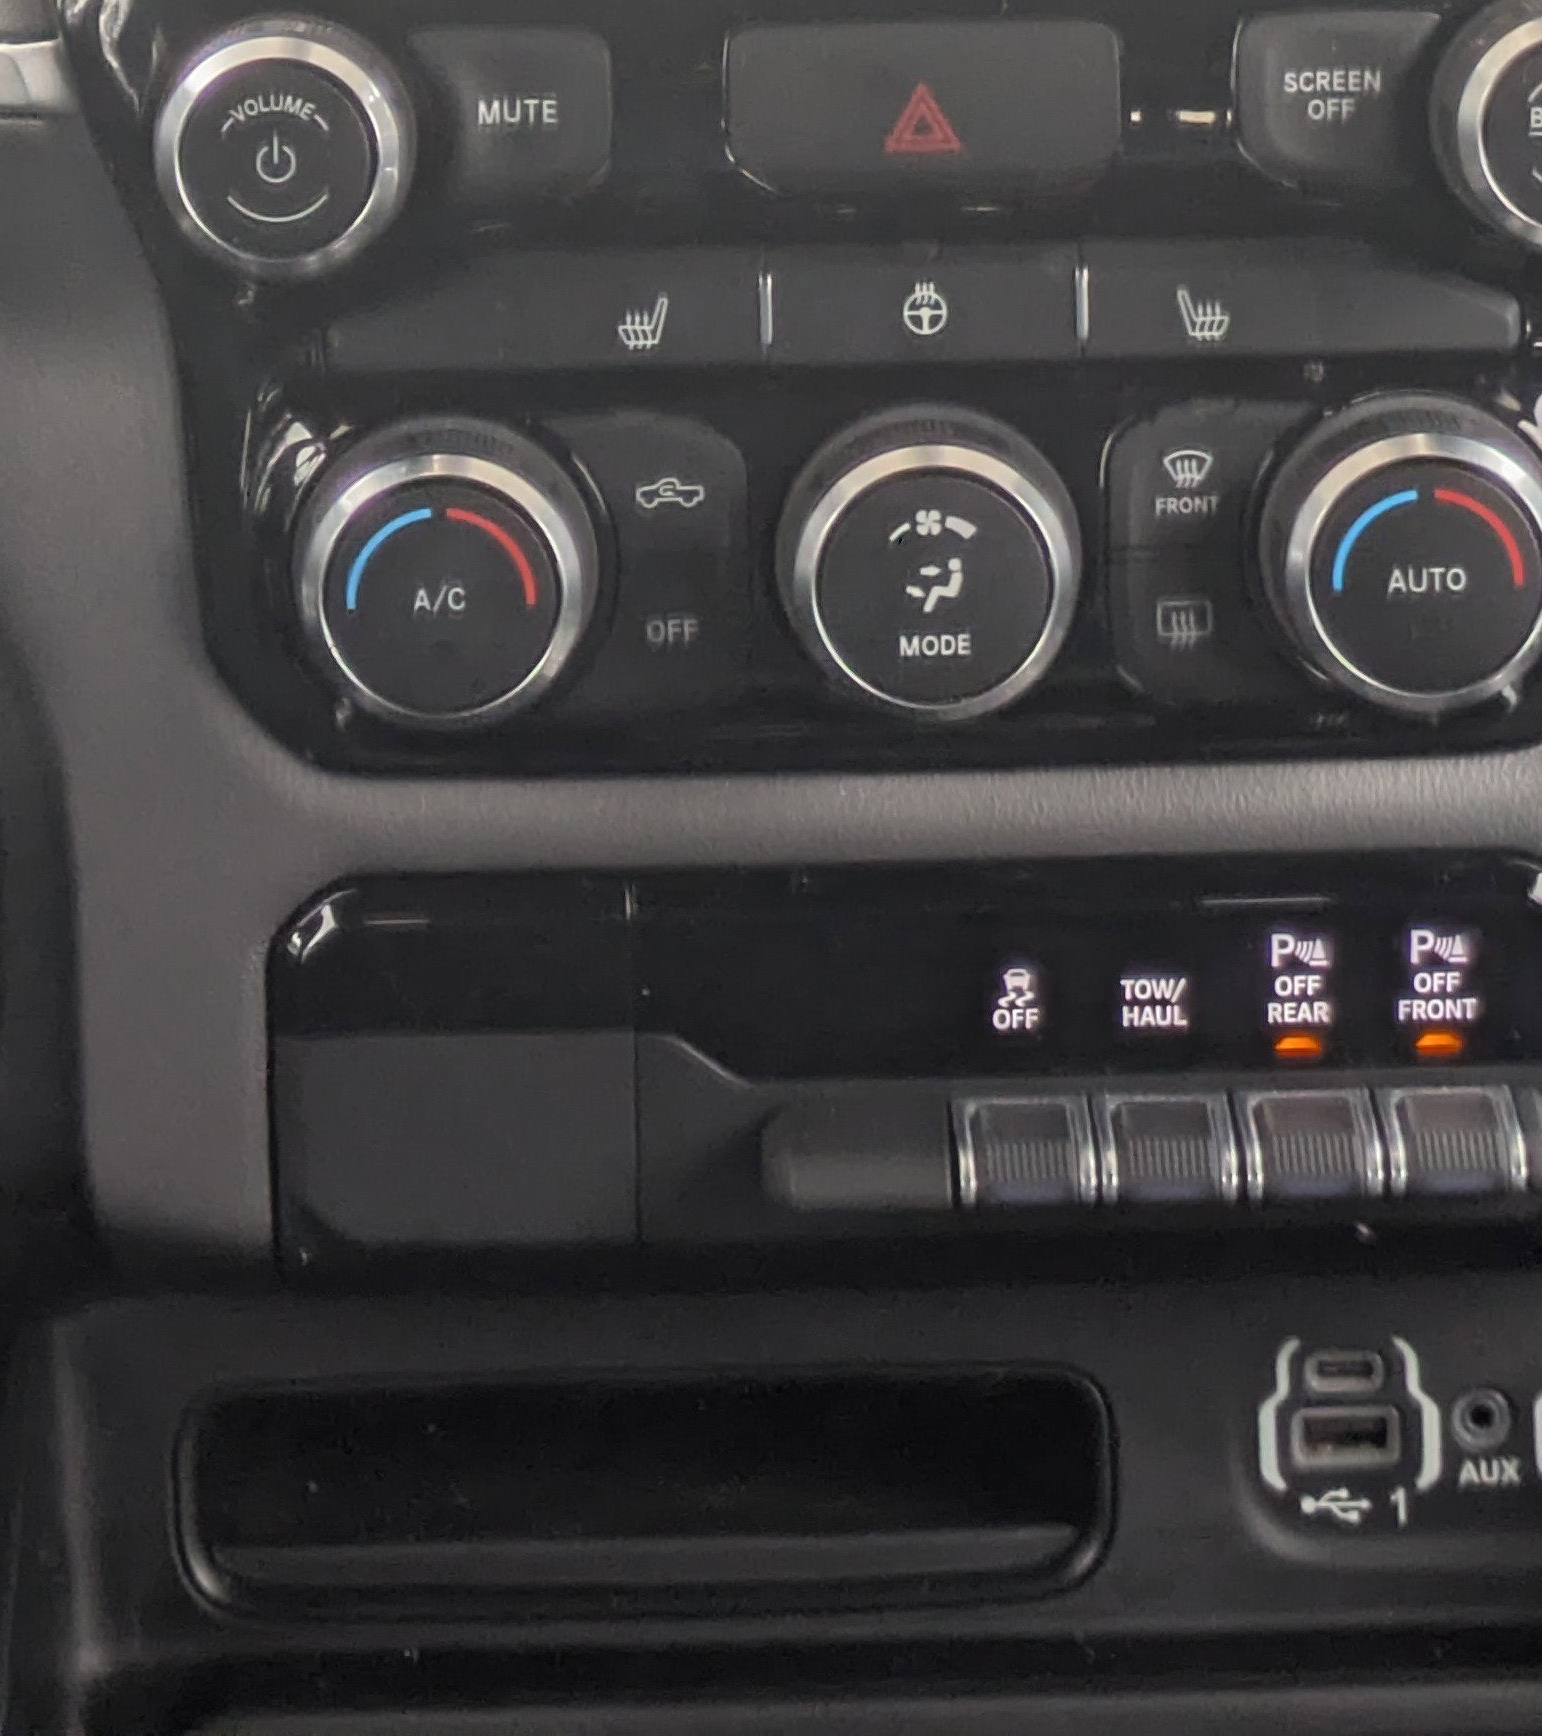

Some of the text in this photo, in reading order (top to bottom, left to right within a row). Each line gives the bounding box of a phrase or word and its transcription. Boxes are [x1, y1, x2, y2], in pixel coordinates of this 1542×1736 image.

[1283, 70, 1381, 92] SCREEN
[229, 94, 316, 122] VOLUME
[477, 97, 558, 125] MUTE
[1307, 99, 1355, 122] OFF
[1155, 496, 1218, 515] FRONT
[1386, 567, 1467, 597] AUTO
[413, 587, 466, 611] A/C
[645, 619, 700, 644] OFF
[899, 634, 971, 657] MODE
[1120, 977, 1187, 1003] TOW/
[1274, 975, 1322, 998] OFF
[1413, 971, 1461, 994] OFF
[992, 1007, 1039, 1030] OFF
[1122, 1004, 1188, 1027] HAUL
[1267, 1002, 1331, 1024] REAR
[1398, 997, 1477, 1021] FRONT
[1459, 1458, 1521, 1485] AUX
